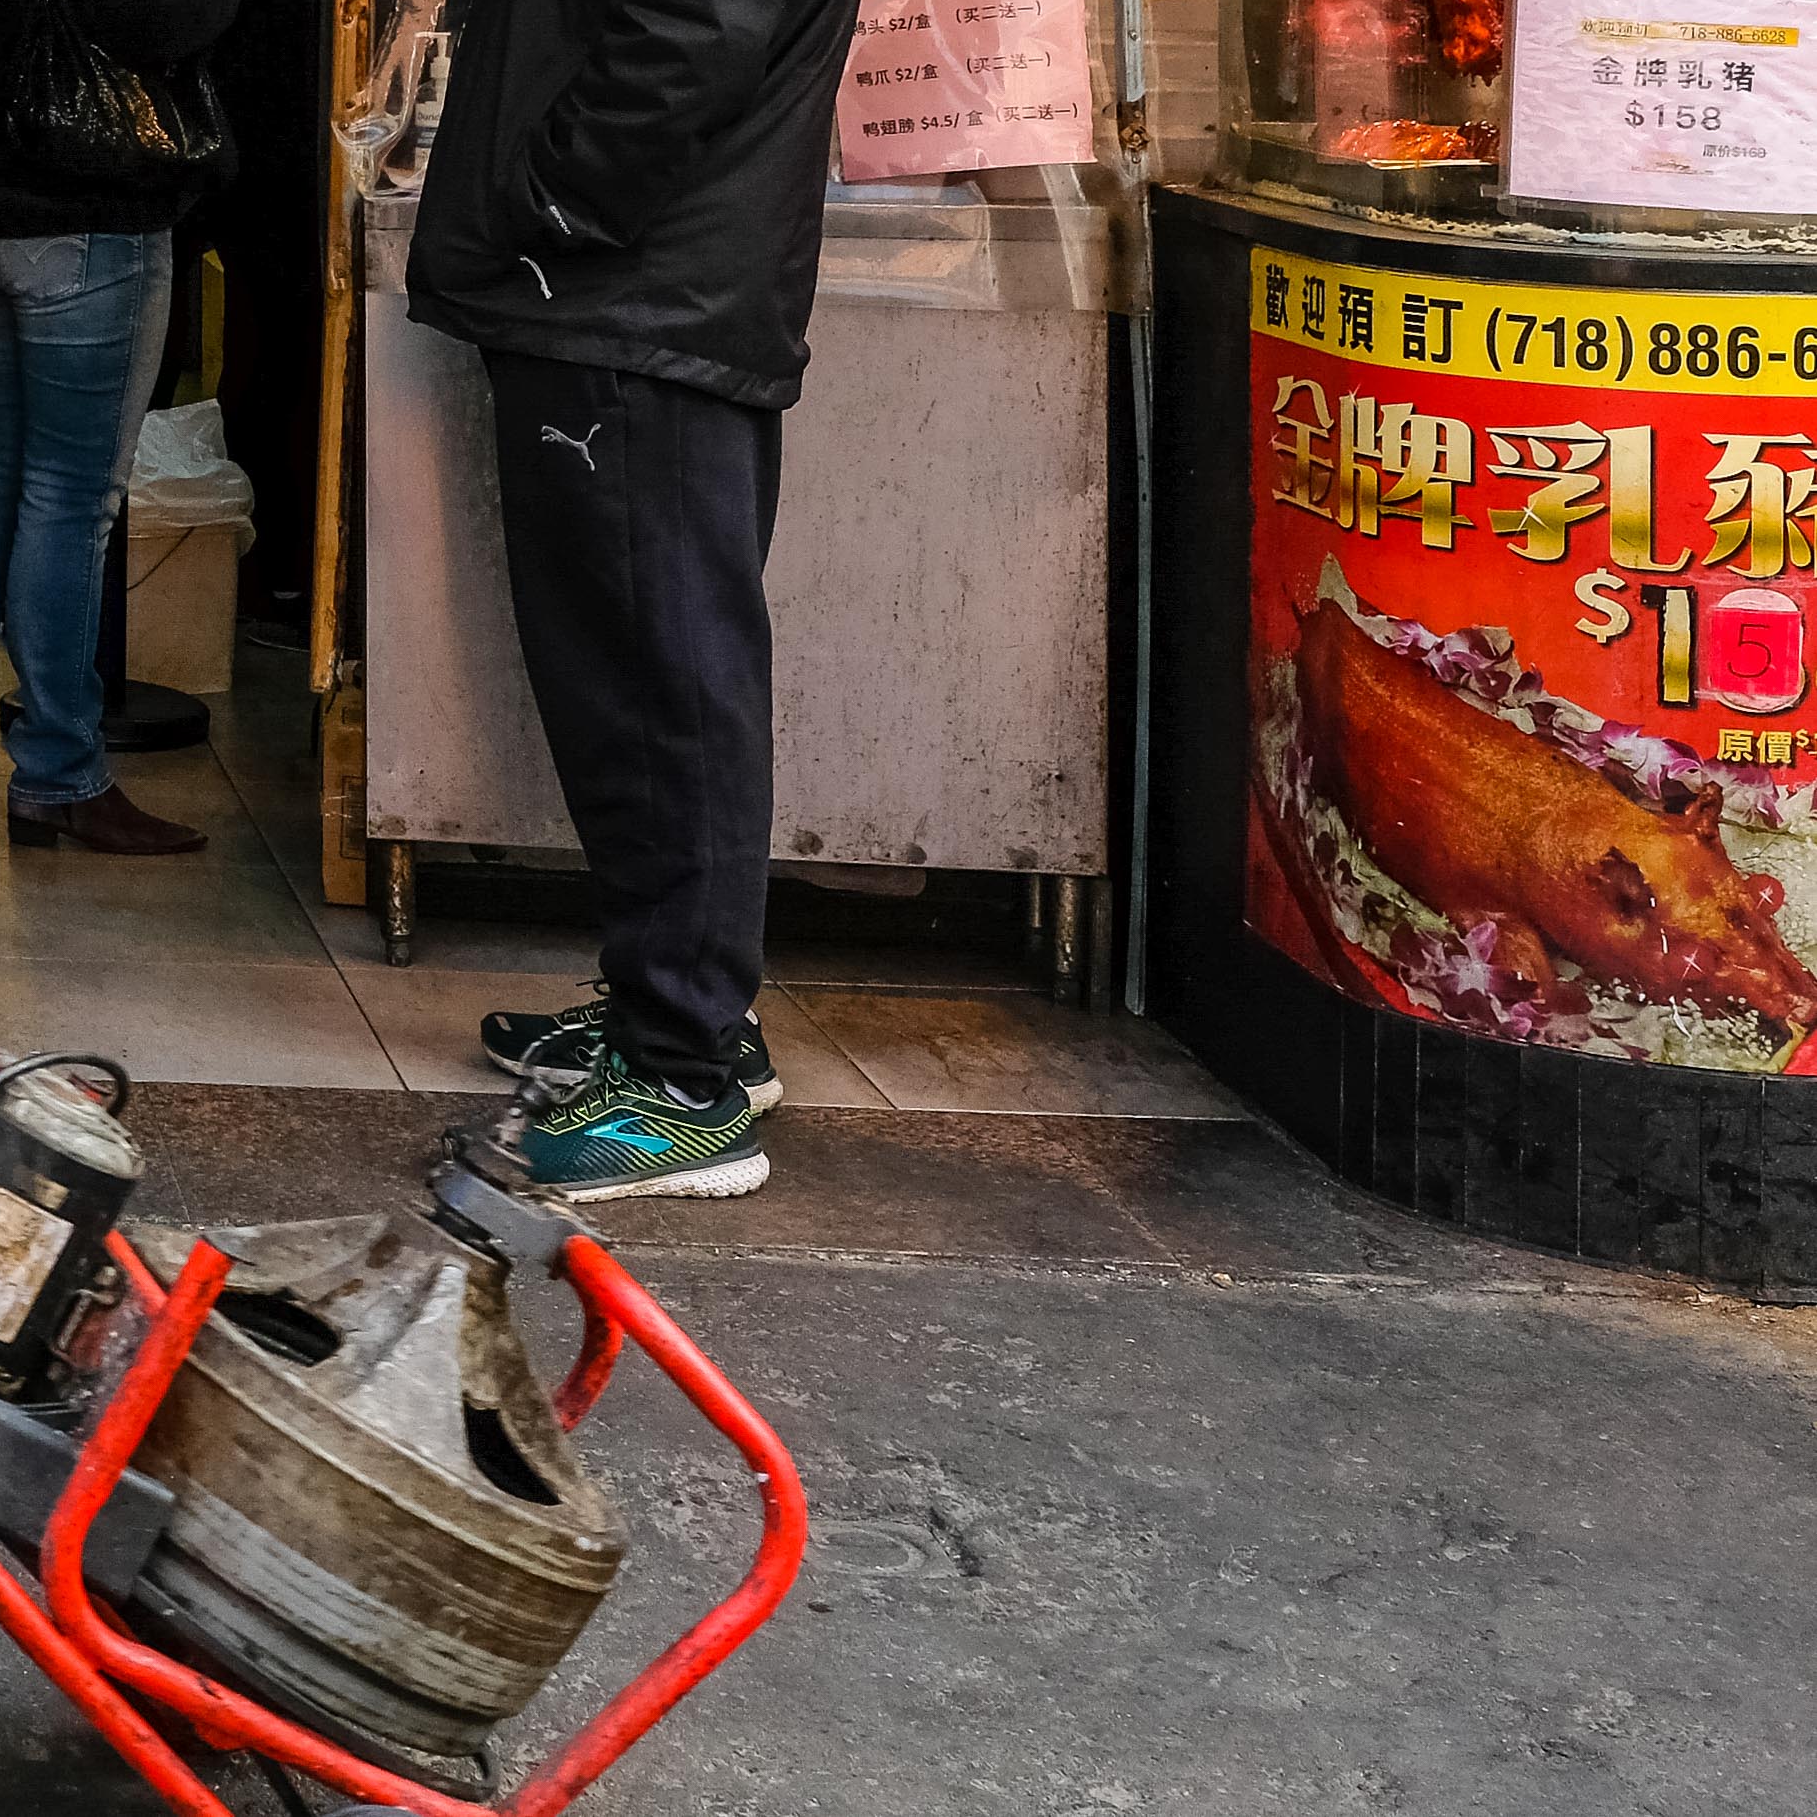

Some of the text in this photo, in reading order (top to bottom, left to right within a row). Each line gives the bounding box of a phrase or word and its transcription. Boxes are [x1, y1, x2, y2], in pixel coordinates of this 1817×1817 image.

[1679, 27, 1786, 43] 718-886-6628
[856, 69, 891, 87] 鸭爪
[1592, 56, 1756, 92] 金牌乳猪
[863, 118, 915, 138] 鸭翅膀
[1625, 100, 1722, 131] $158
[1265, 263, 1465, 363] 歡迎預訂
